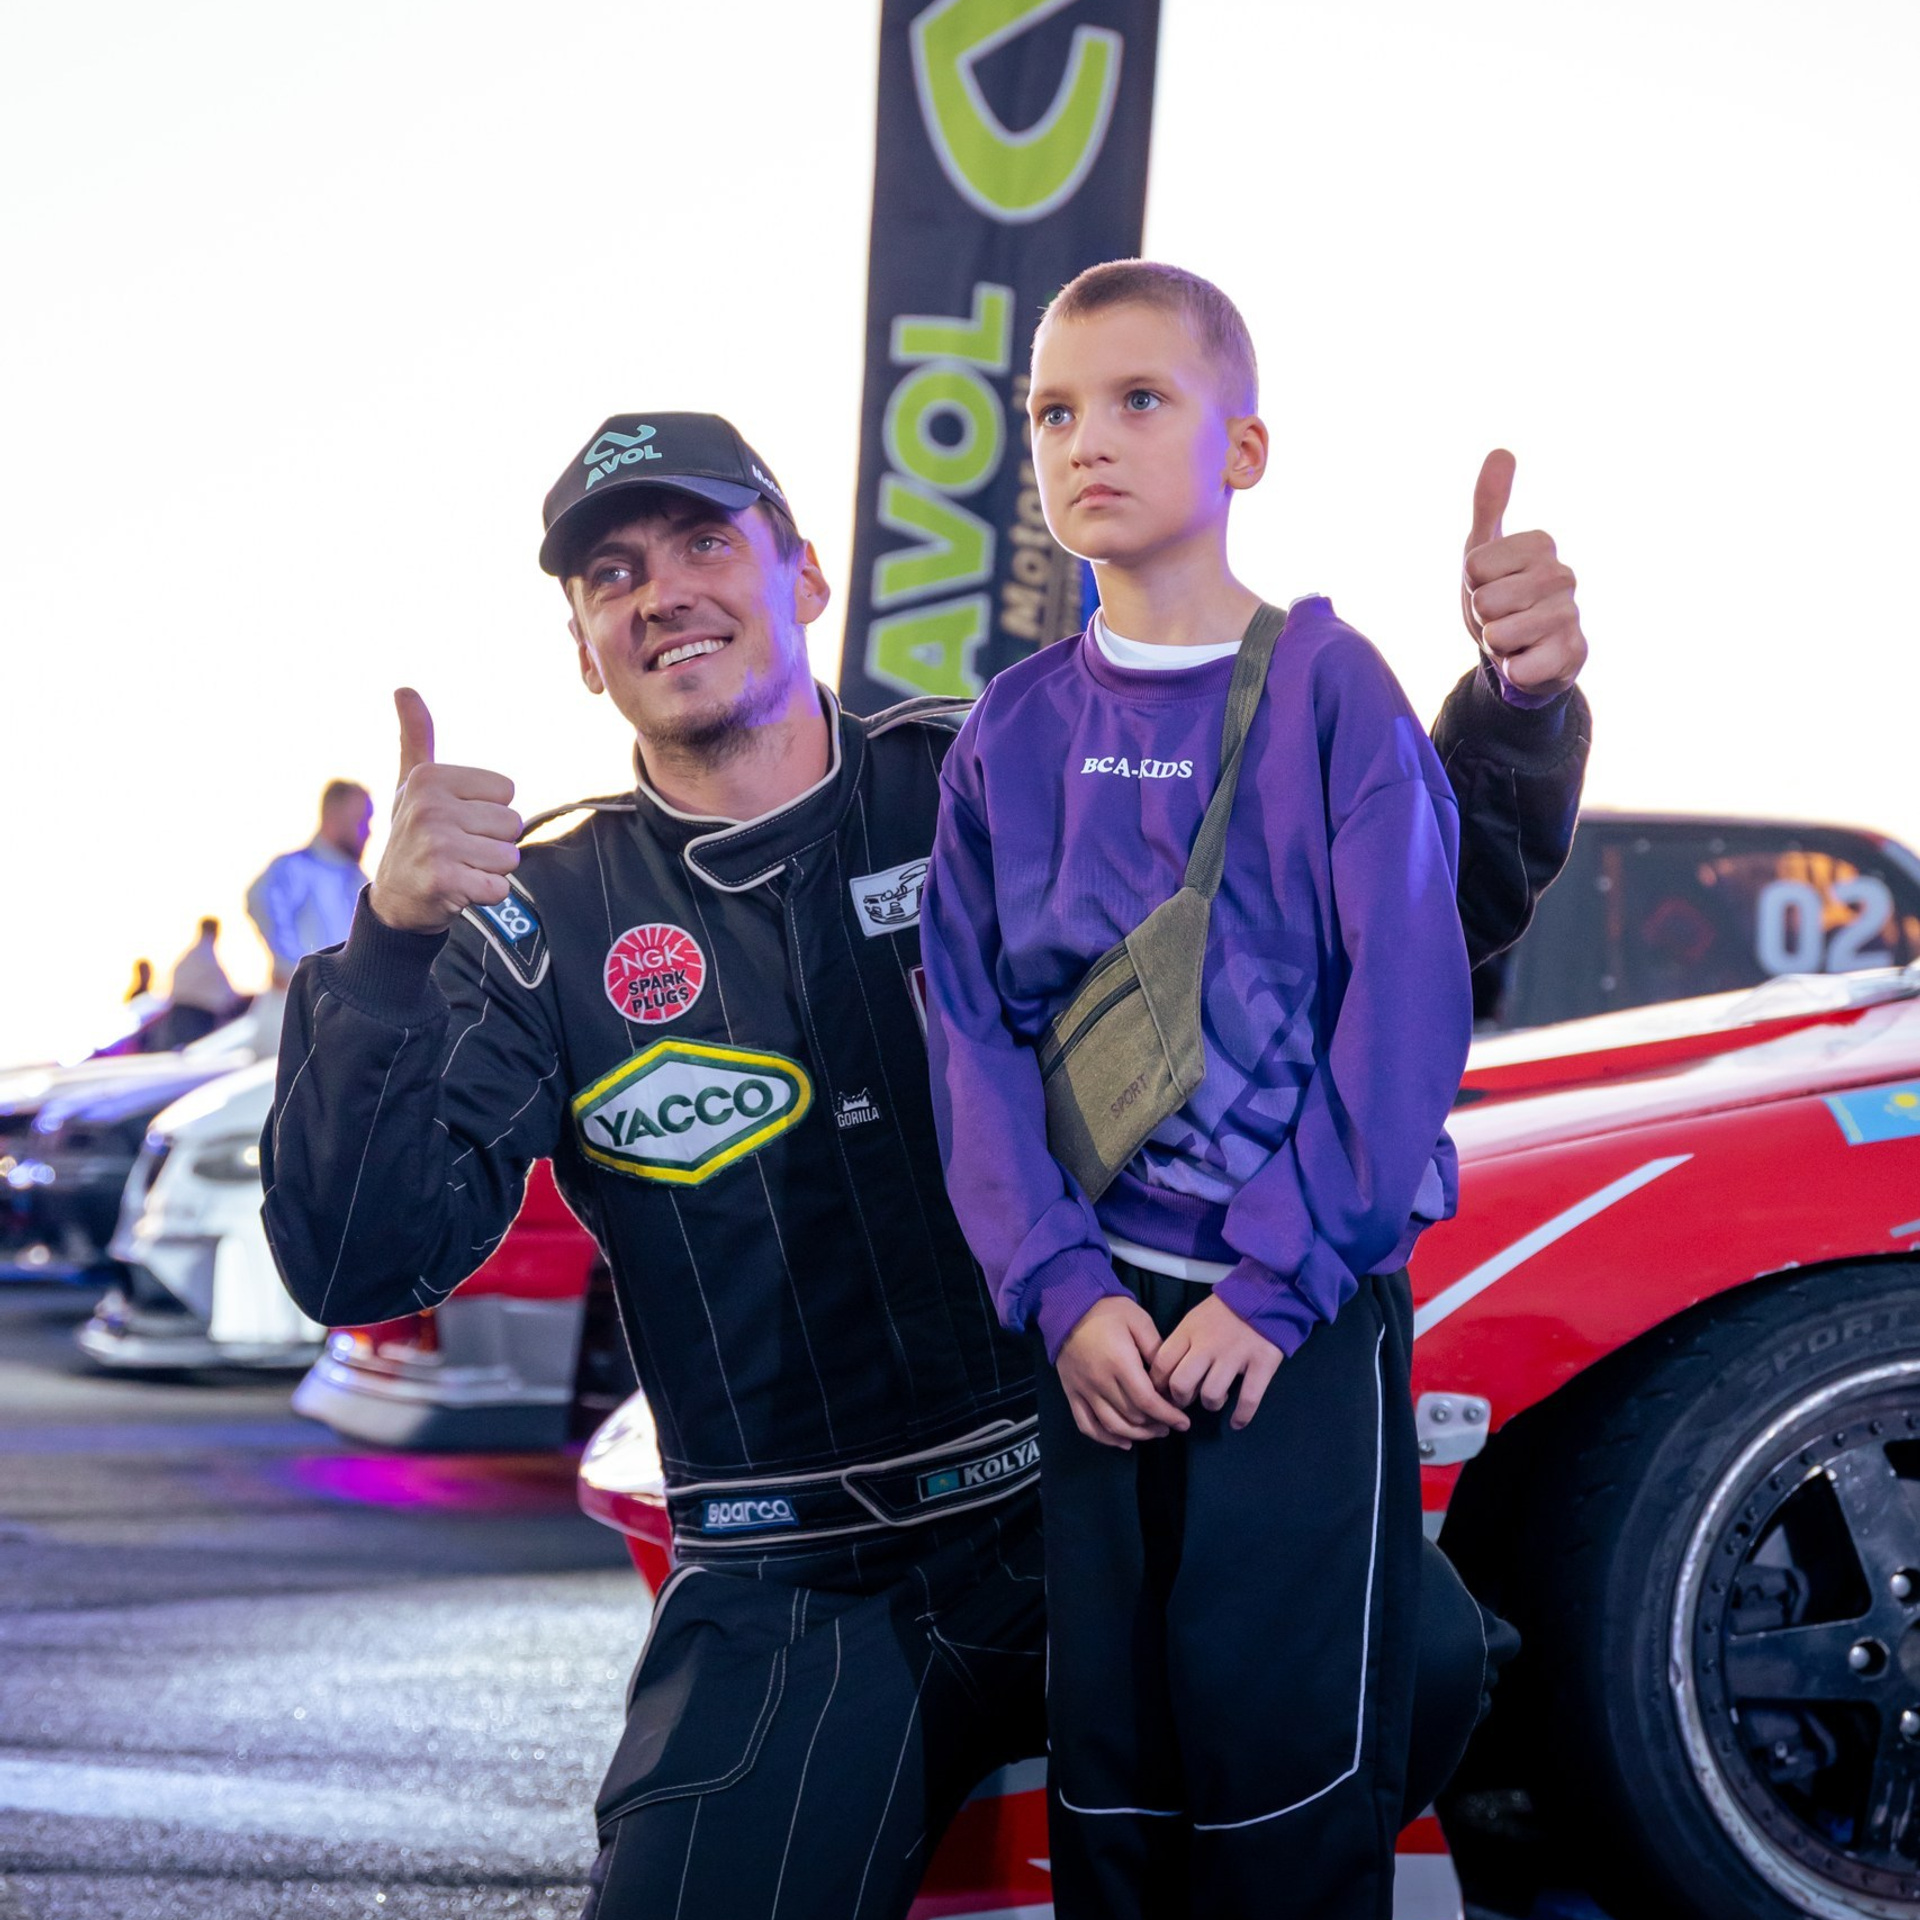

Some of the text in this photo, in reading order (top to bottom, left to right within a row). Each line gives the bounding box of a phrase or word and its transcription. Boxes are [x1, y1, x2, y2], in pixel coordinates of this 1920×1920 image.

[585, 444, 663, 491] AVOL
[864, 281, 1015, 699] AVOL
[1080, 756, 1194, 779] BCA-KIDS
[1755, 874, 1895, 976] 02
[620, 943, 685, 977] NGK
[628, 969, 687, 996] SPARK
[632, 986, 689, 1013] PLUGS
[1109, 1071, 1150, 1120] SPORT
[594, 1078, 774, 1148] YACCO
[836, 1105, 881, 1128] GORILLA
[707, 1500, 791, 1529] sparco
